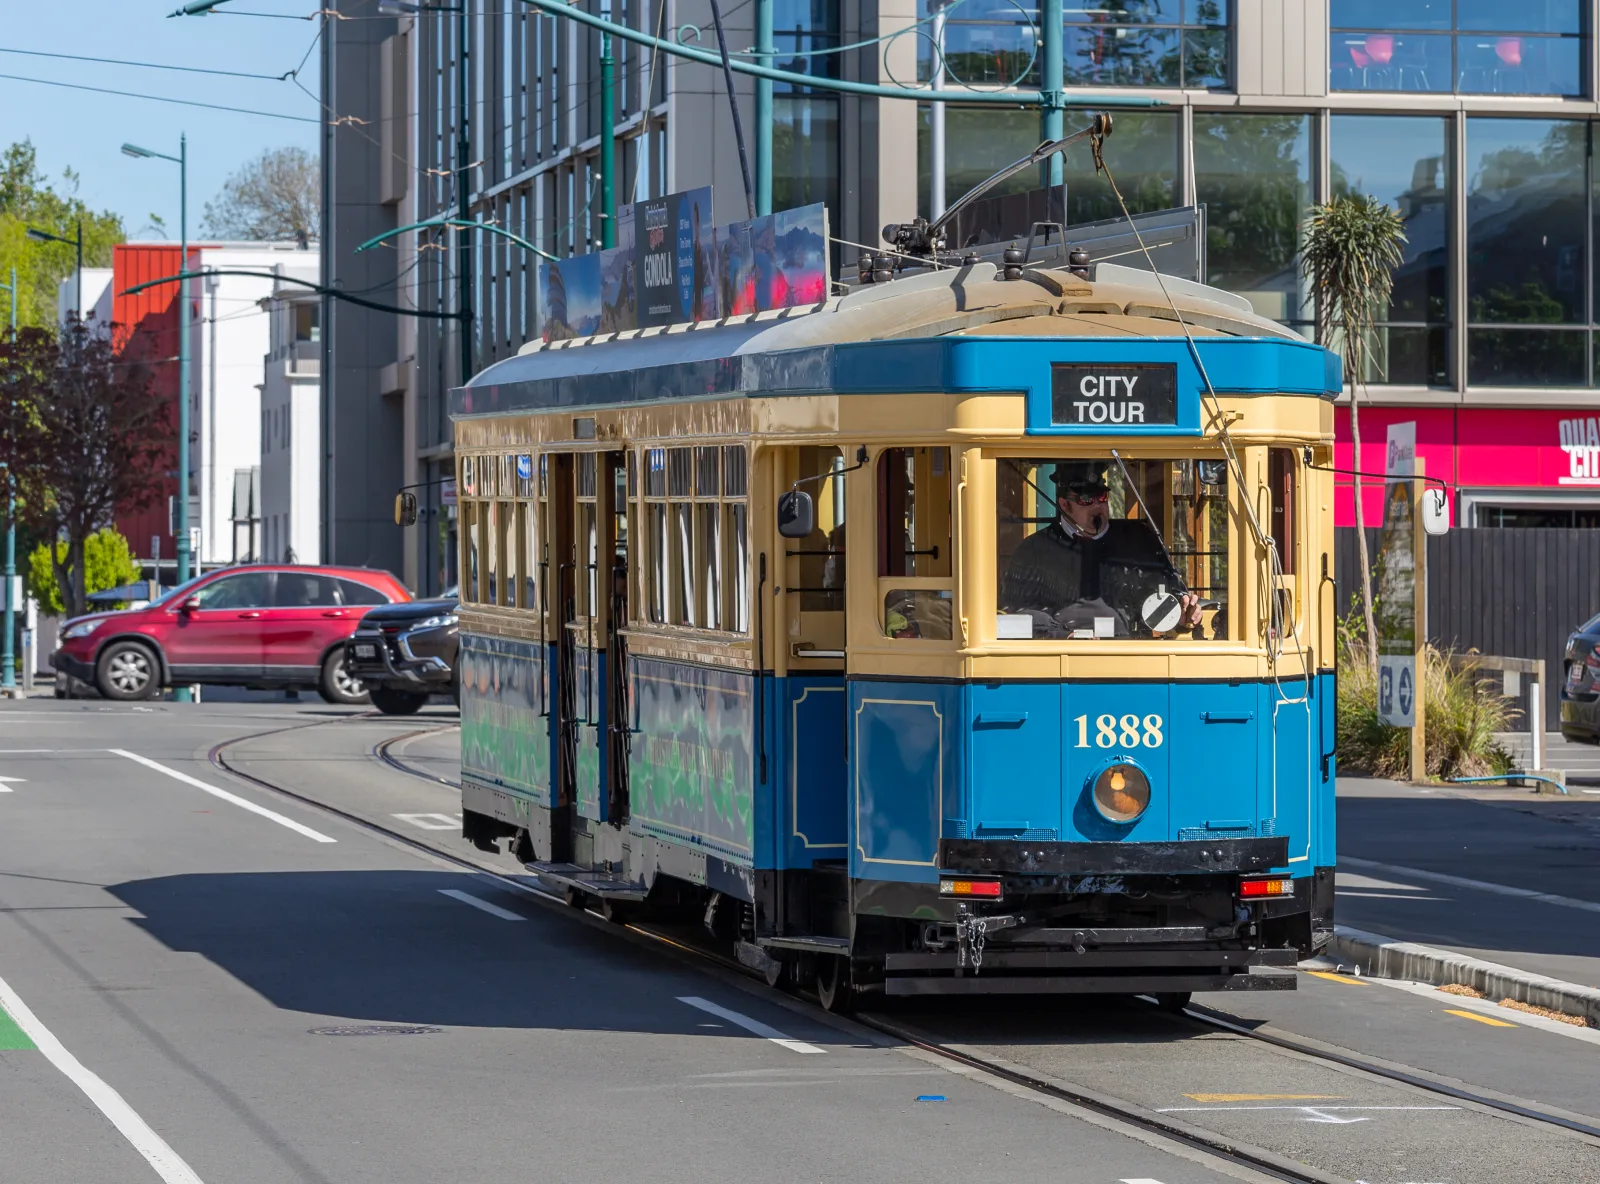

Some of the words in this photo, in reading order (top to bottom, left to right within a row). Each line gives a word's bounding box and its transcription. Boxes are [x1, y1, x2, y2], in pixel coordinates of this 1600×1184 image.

[644, 251, 673, 288] GONDOLA
[1080, 375, 1138, 397] CITY
[1073, 401, 1145, 423] TOUR
[1559, 417, 1600, 453] QUA
[1074, 714, 1164, 748] 1888
